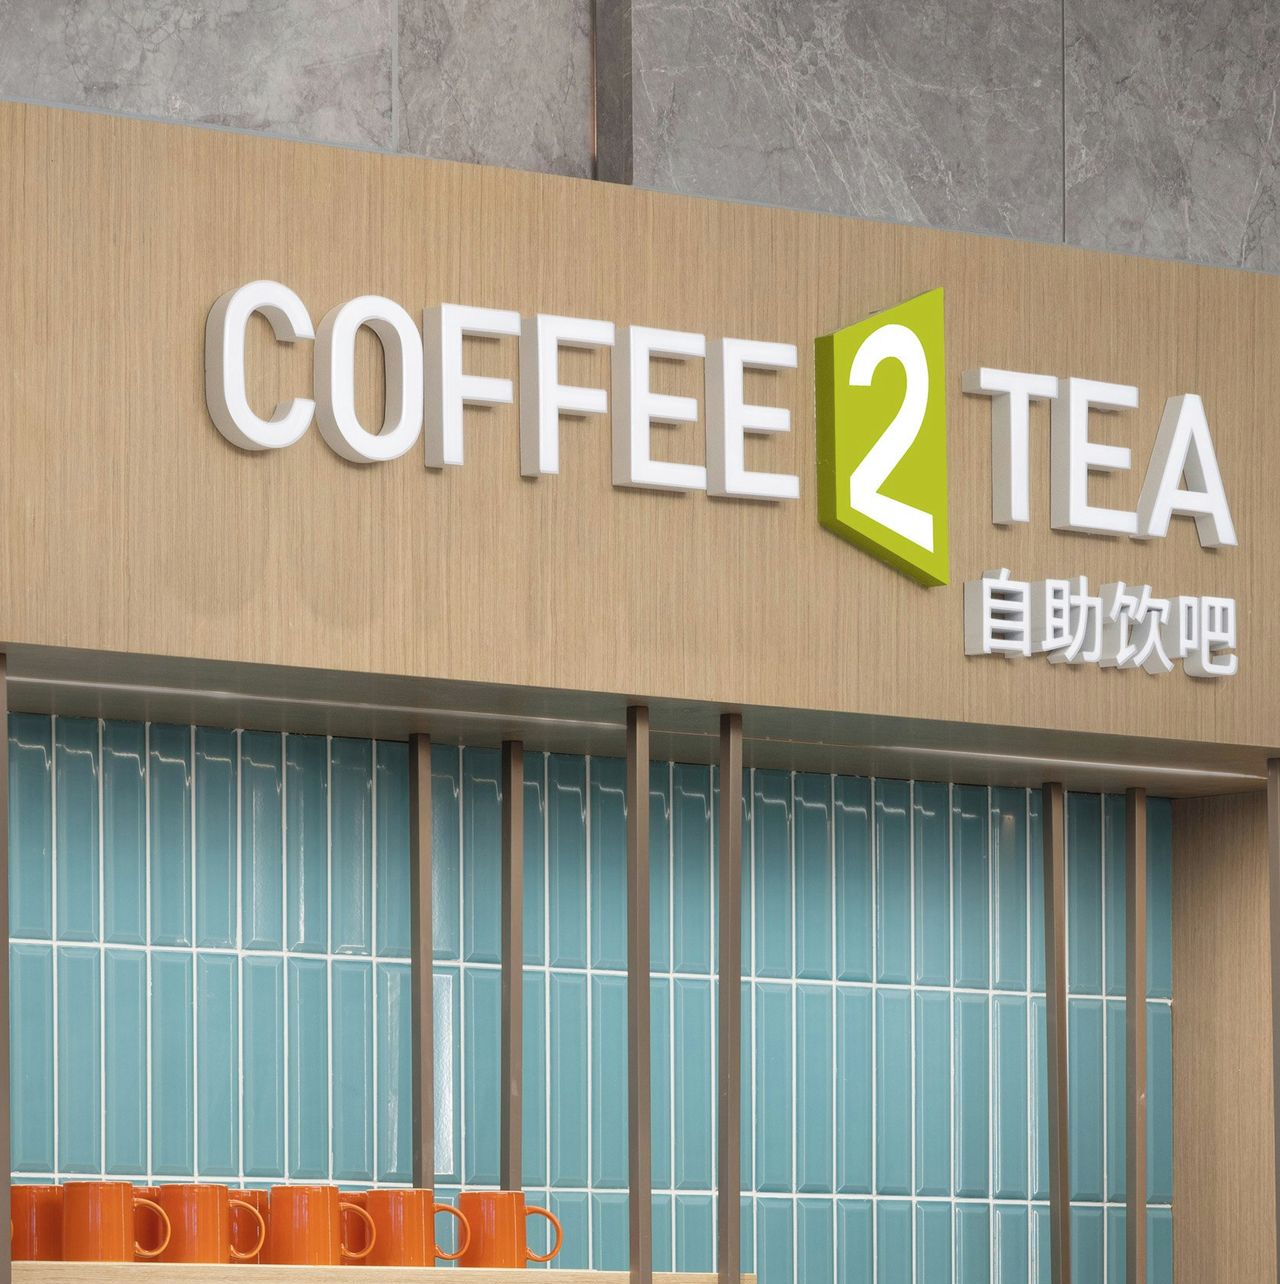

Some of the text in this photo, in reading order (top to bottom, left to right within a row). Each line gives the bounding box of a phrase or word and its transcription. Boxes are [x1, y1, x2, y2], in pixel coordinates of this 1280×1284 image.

[206, 279, 1238, 553] COFFEE 2 TEA
[967, 568, 1238, 676] 自助饮吧
